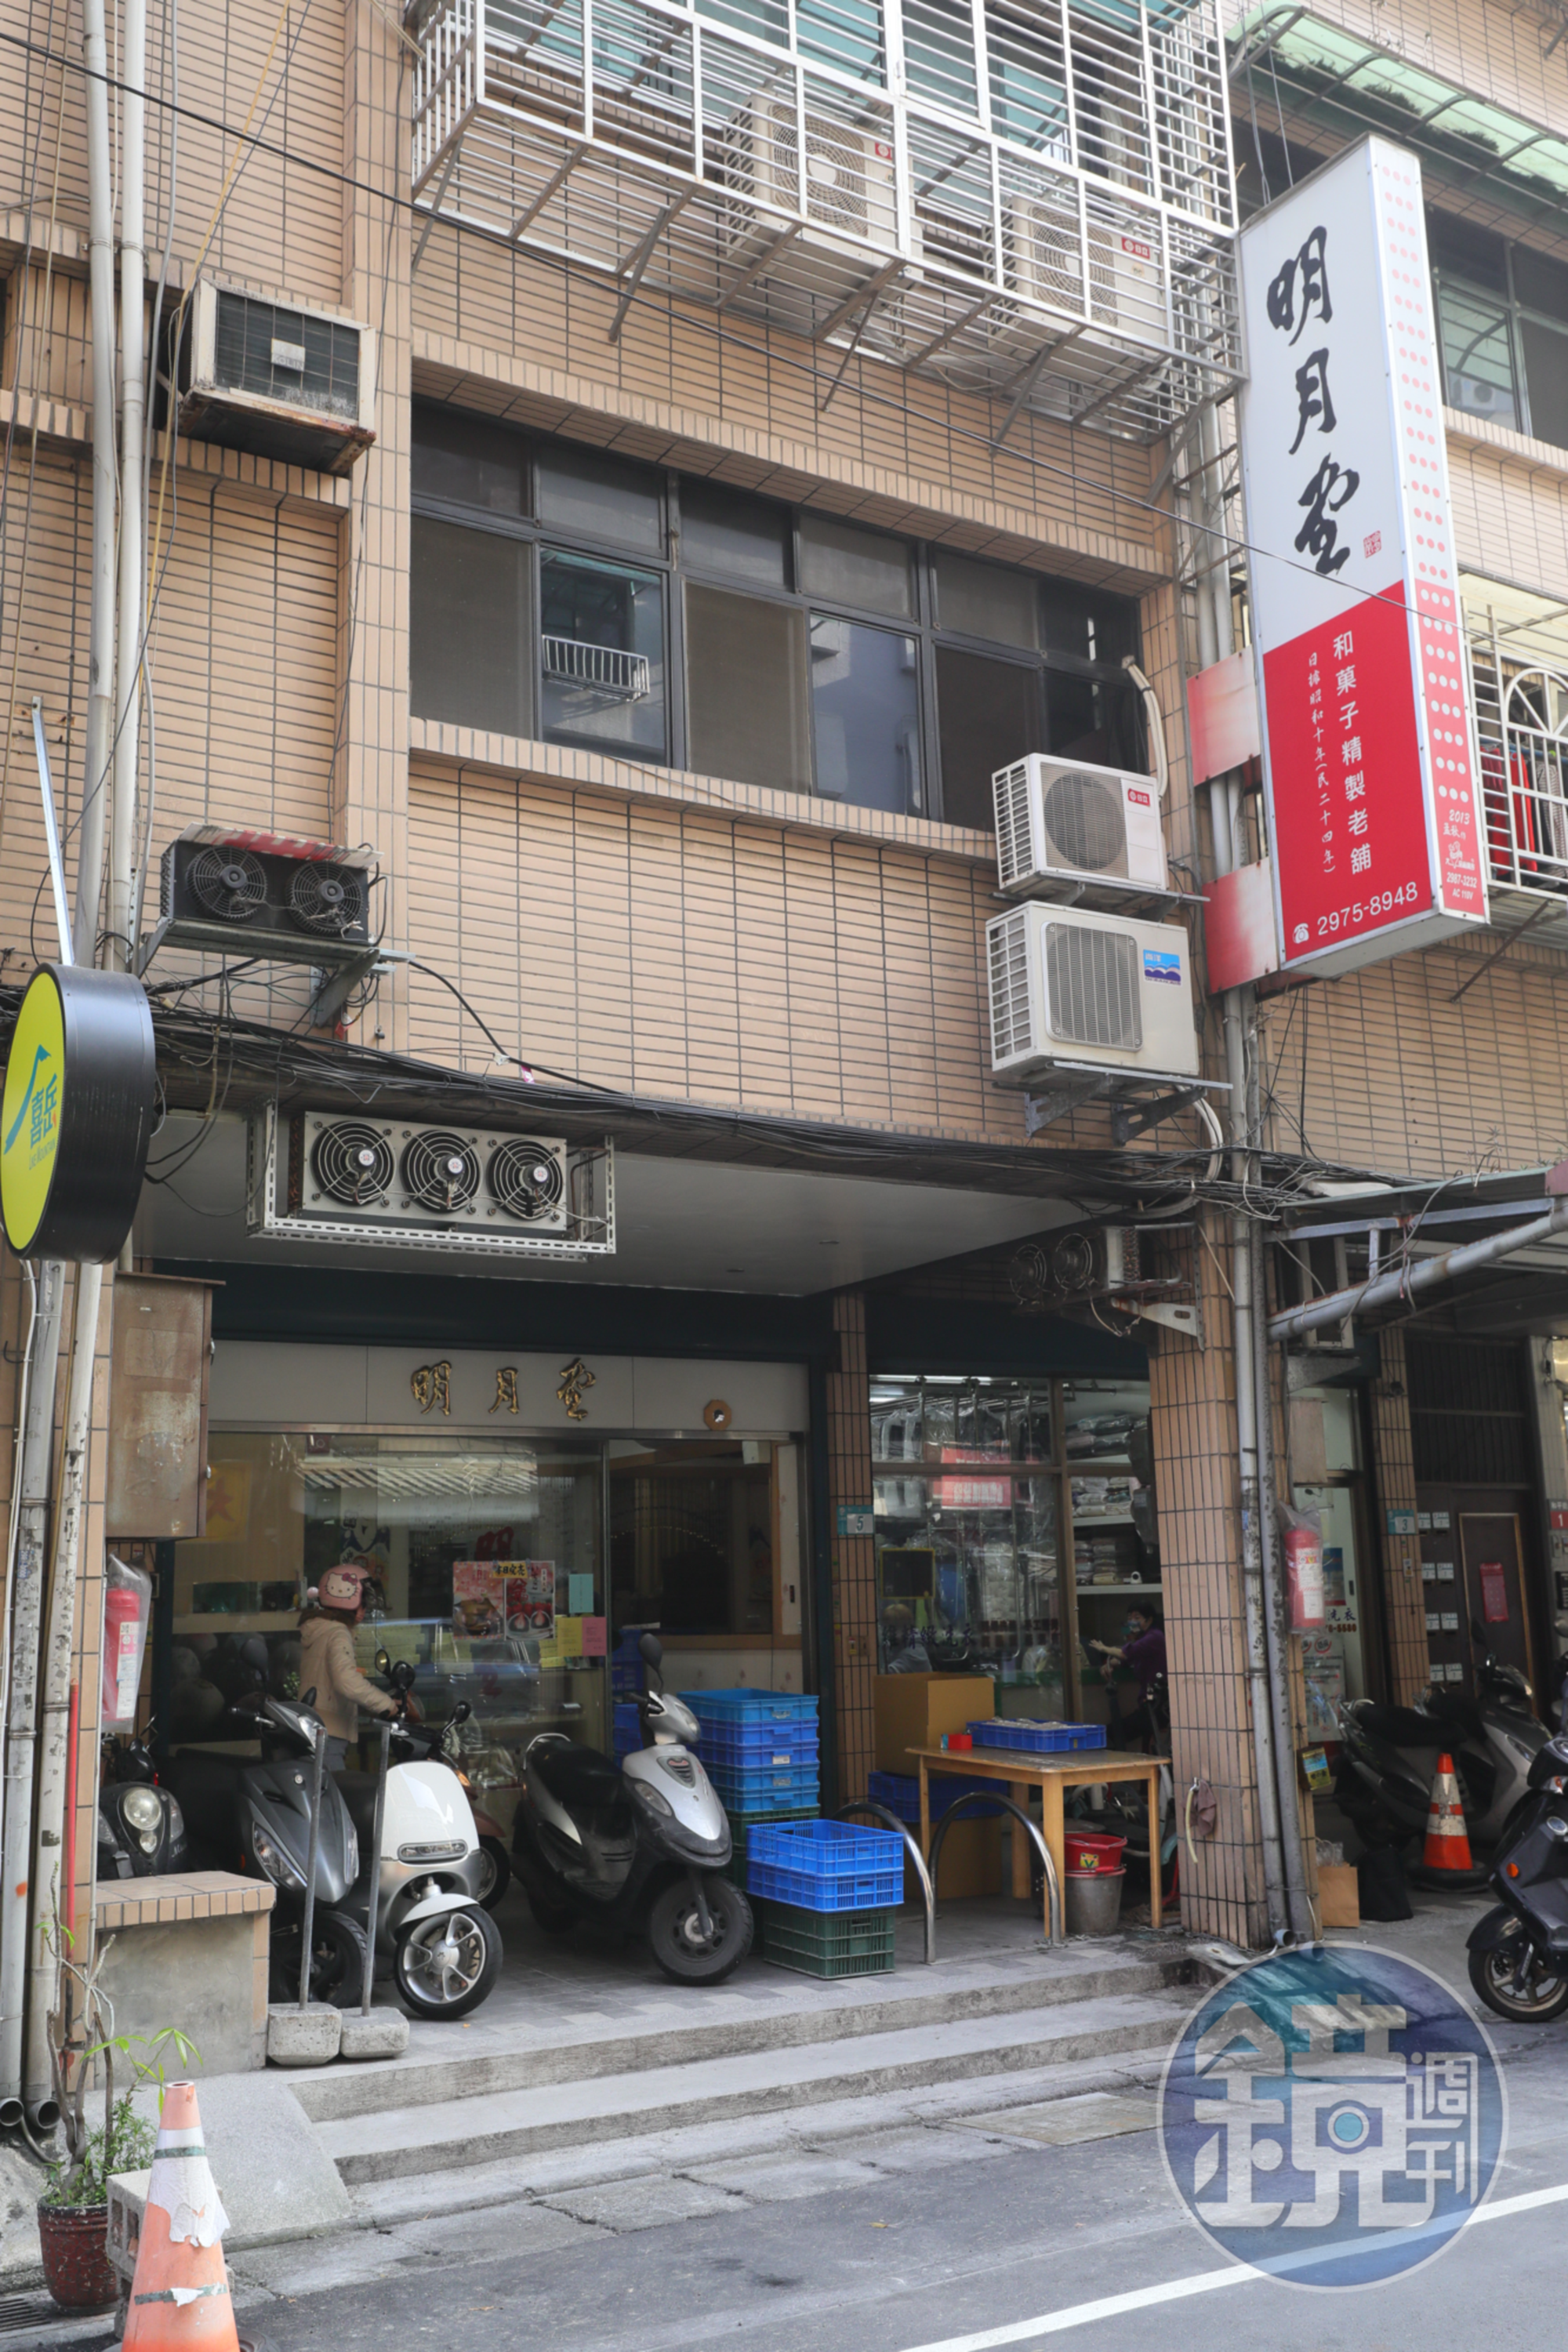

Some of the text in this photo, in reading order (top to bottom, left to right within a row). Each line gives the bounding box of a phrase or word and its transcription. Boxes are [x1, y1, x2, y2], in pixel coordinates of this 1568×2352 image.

[271, 353, 305, 372] KOLIN
[1267, 225, 1359, 575] 明月堂
[1333, 630, 1372, 875] 和菓子精製老舖
[1449, 808, 1470, 826] 2013
[1446, 871, 1477, 889] 2987-3232
[1452, 887, 1474, 901] AC 110V
[1317, 881, 1418, 936] 2975-8948
[410, 1356, 596, 1421] 明月堂
[856, 1515, 864, 1532] 5
[1402, 1519, 1408, 1532] 3
[1558, 1513, 1563, 1527] 1
[1327, 1607, 1356, 1621] 洗衣
